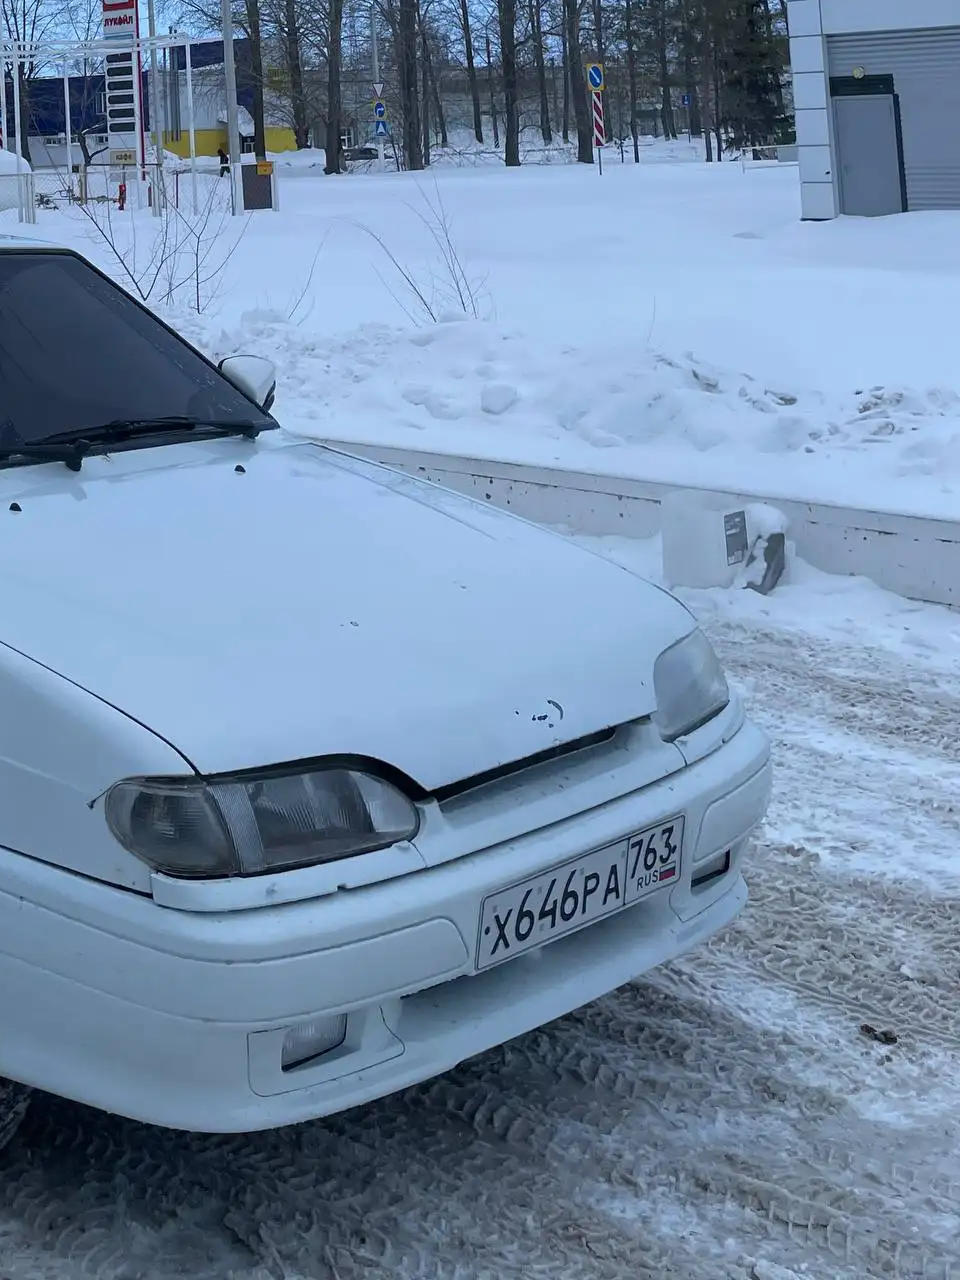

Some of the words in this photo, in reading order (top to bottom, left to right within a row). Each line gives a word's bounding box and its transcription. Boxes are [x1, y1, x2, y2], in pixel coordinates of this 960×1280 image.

[490, 863, 620, 956] Х646РА
[630, 825, 674, 879] 763
[636, 870, 659, 892] RUS
